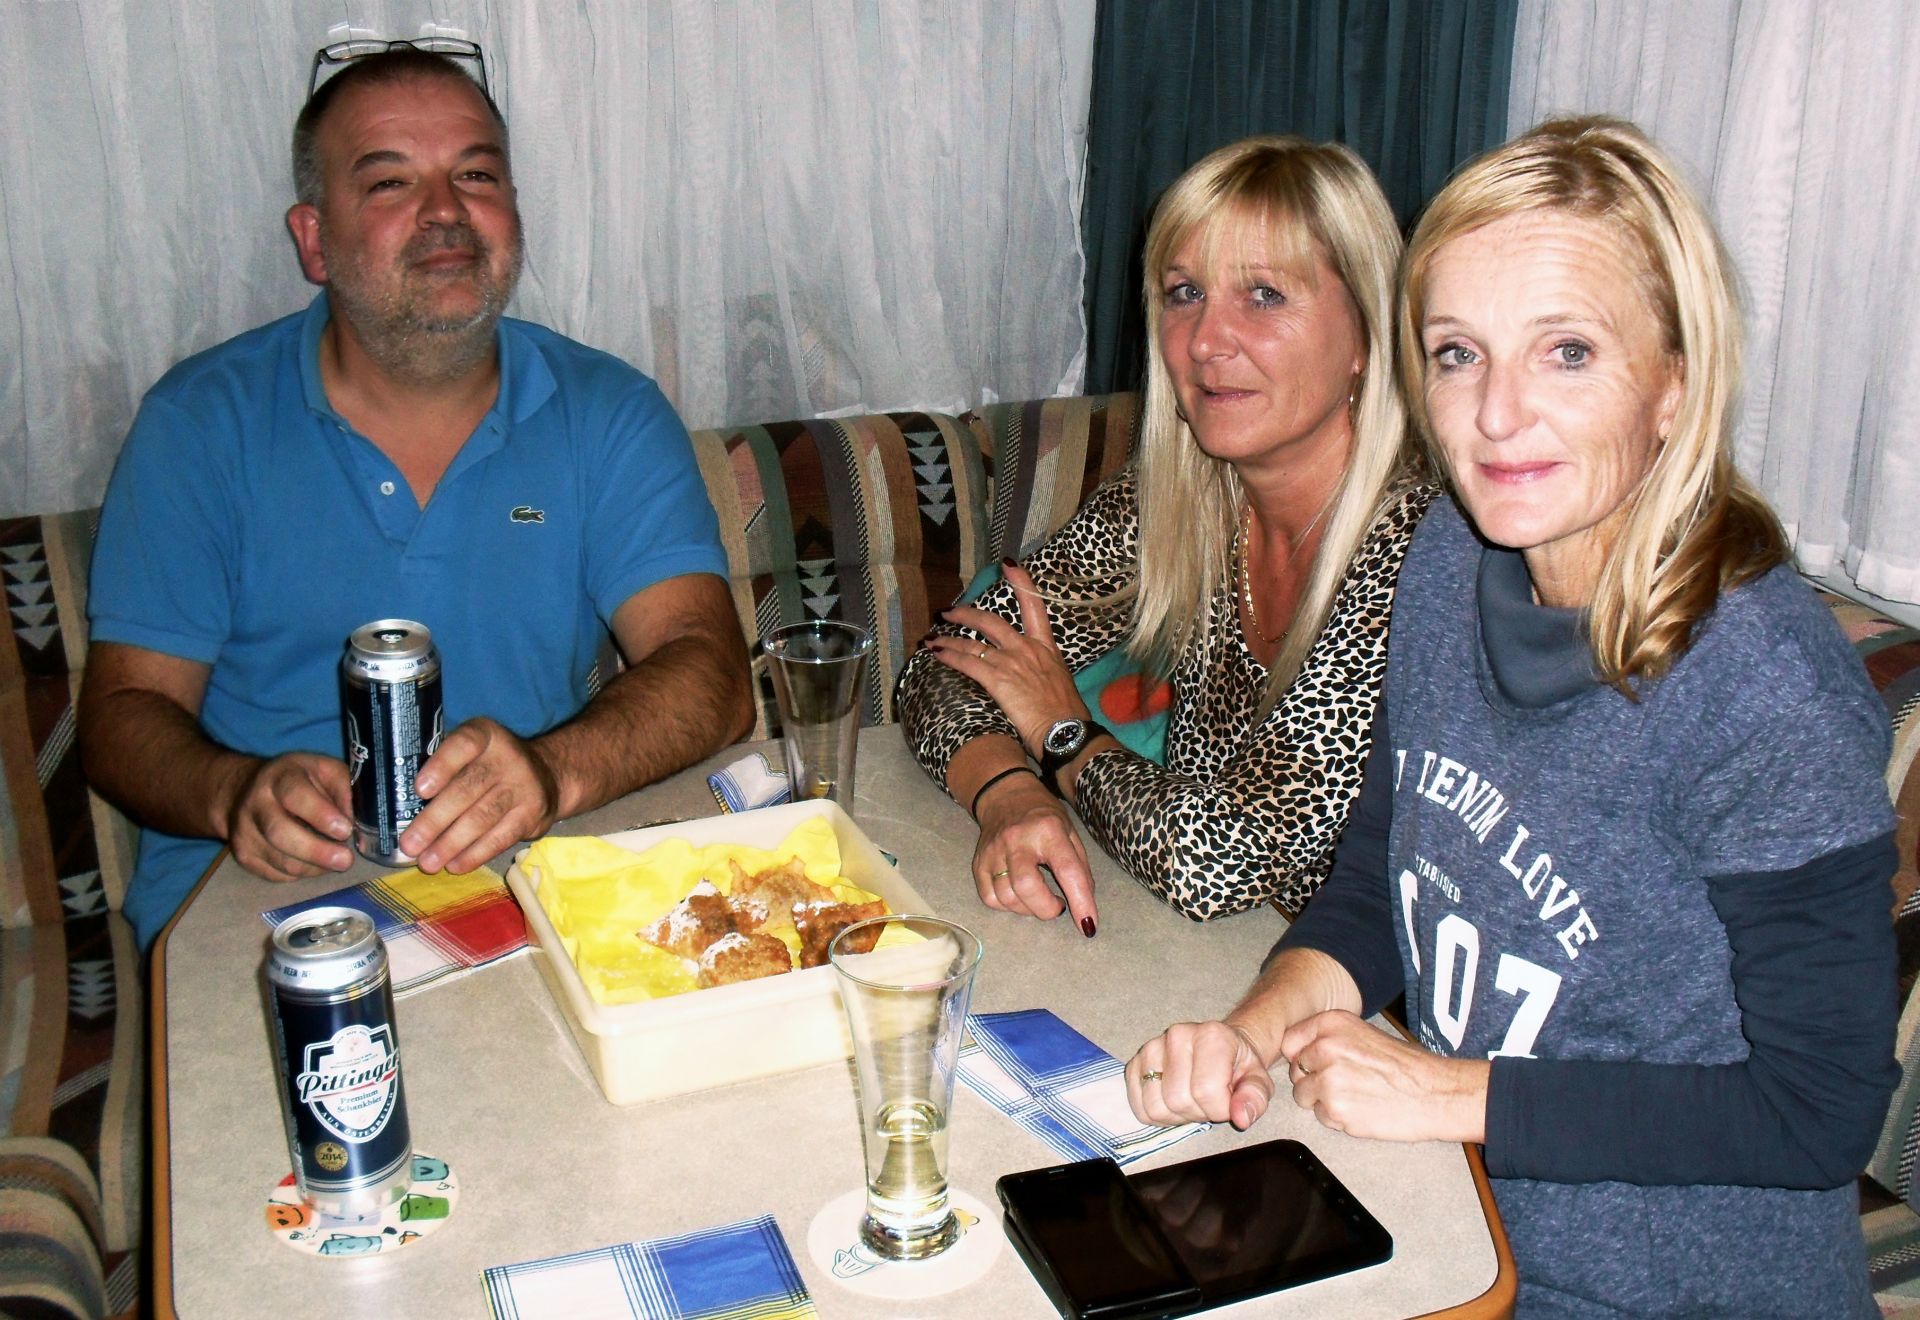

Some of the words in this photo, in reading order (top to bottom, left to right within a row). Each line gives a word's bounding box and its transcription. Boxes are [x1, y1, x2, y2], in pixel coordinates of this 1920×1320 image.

[1499, 824, 1599, 960] LOVE
[340, 1090, 378, 1105] Premium
[321, 1112, 340, 1129] AUS
[320, 1153, 343, 1161] 2014
